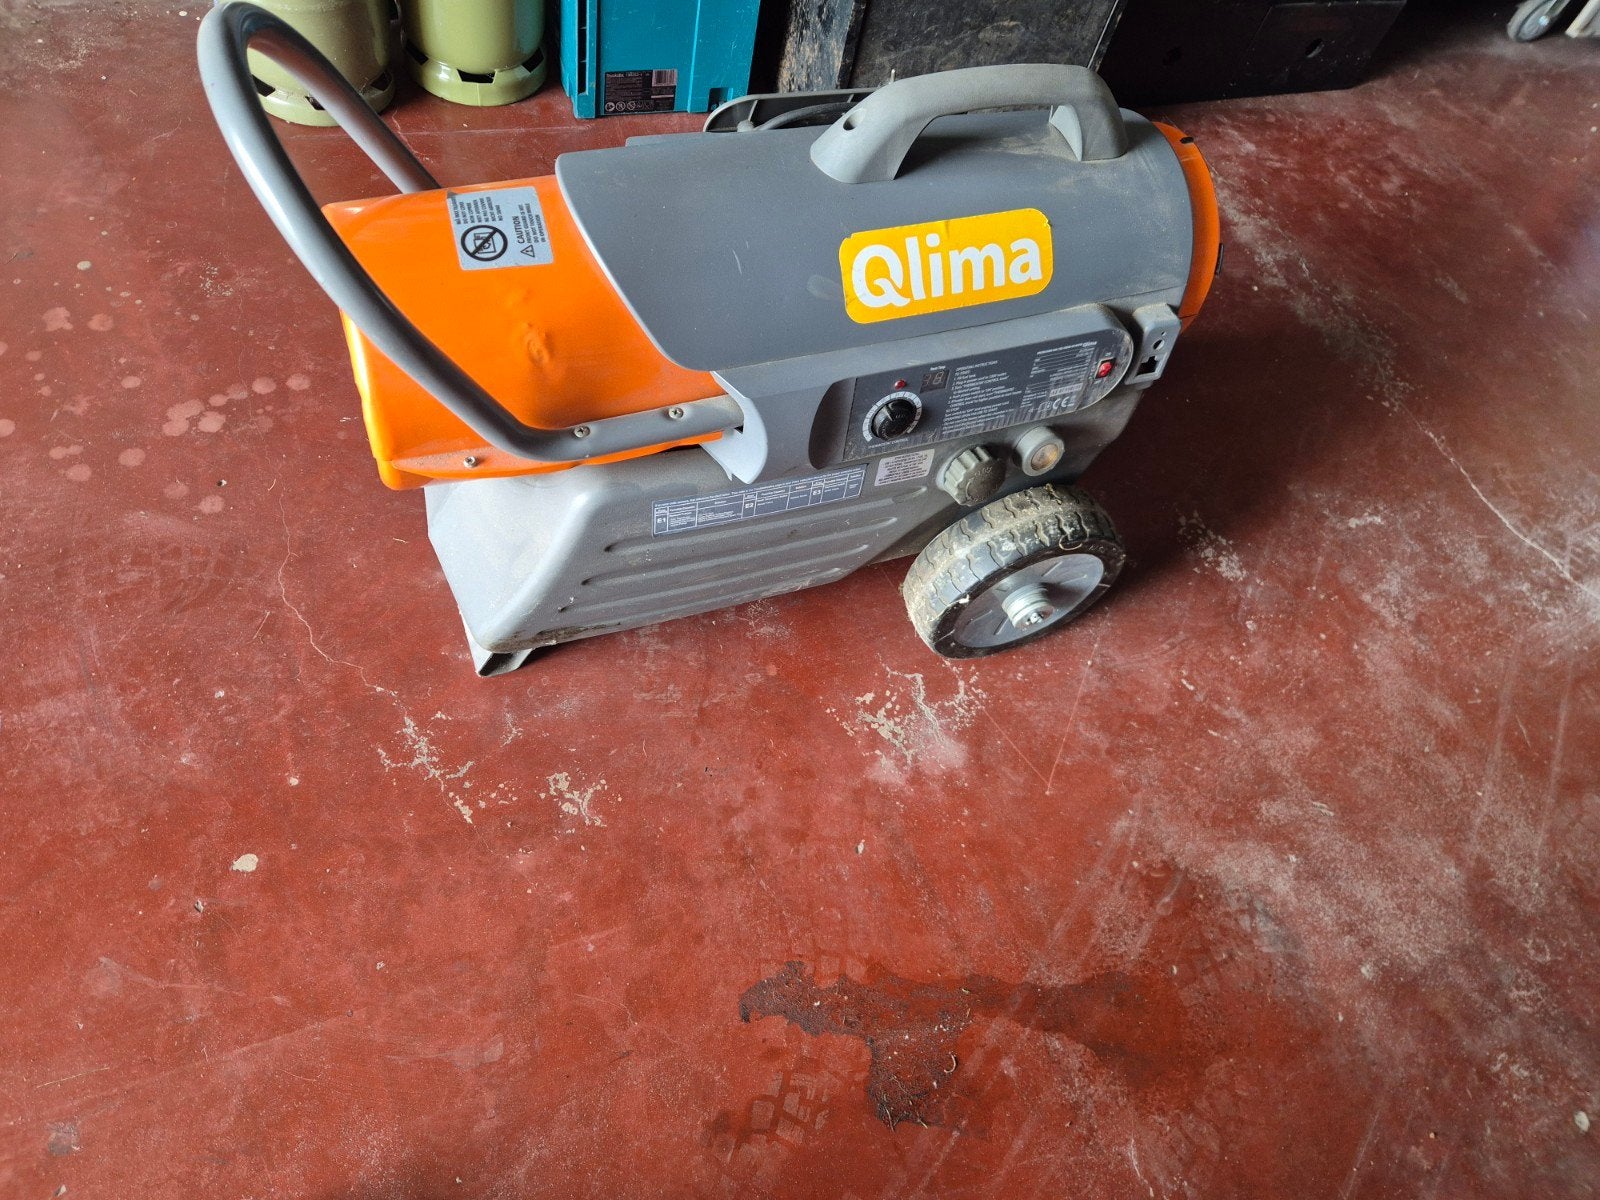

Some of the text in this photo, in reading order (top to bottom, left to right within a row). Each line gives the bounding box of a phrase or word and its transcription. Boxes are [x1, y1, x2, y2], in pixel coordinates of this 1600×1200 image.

[512, 215, 524, 243] CAUTION
[535, 214, 545, 236] OPERATION
[852, 233, 1042, 308] Qlima
